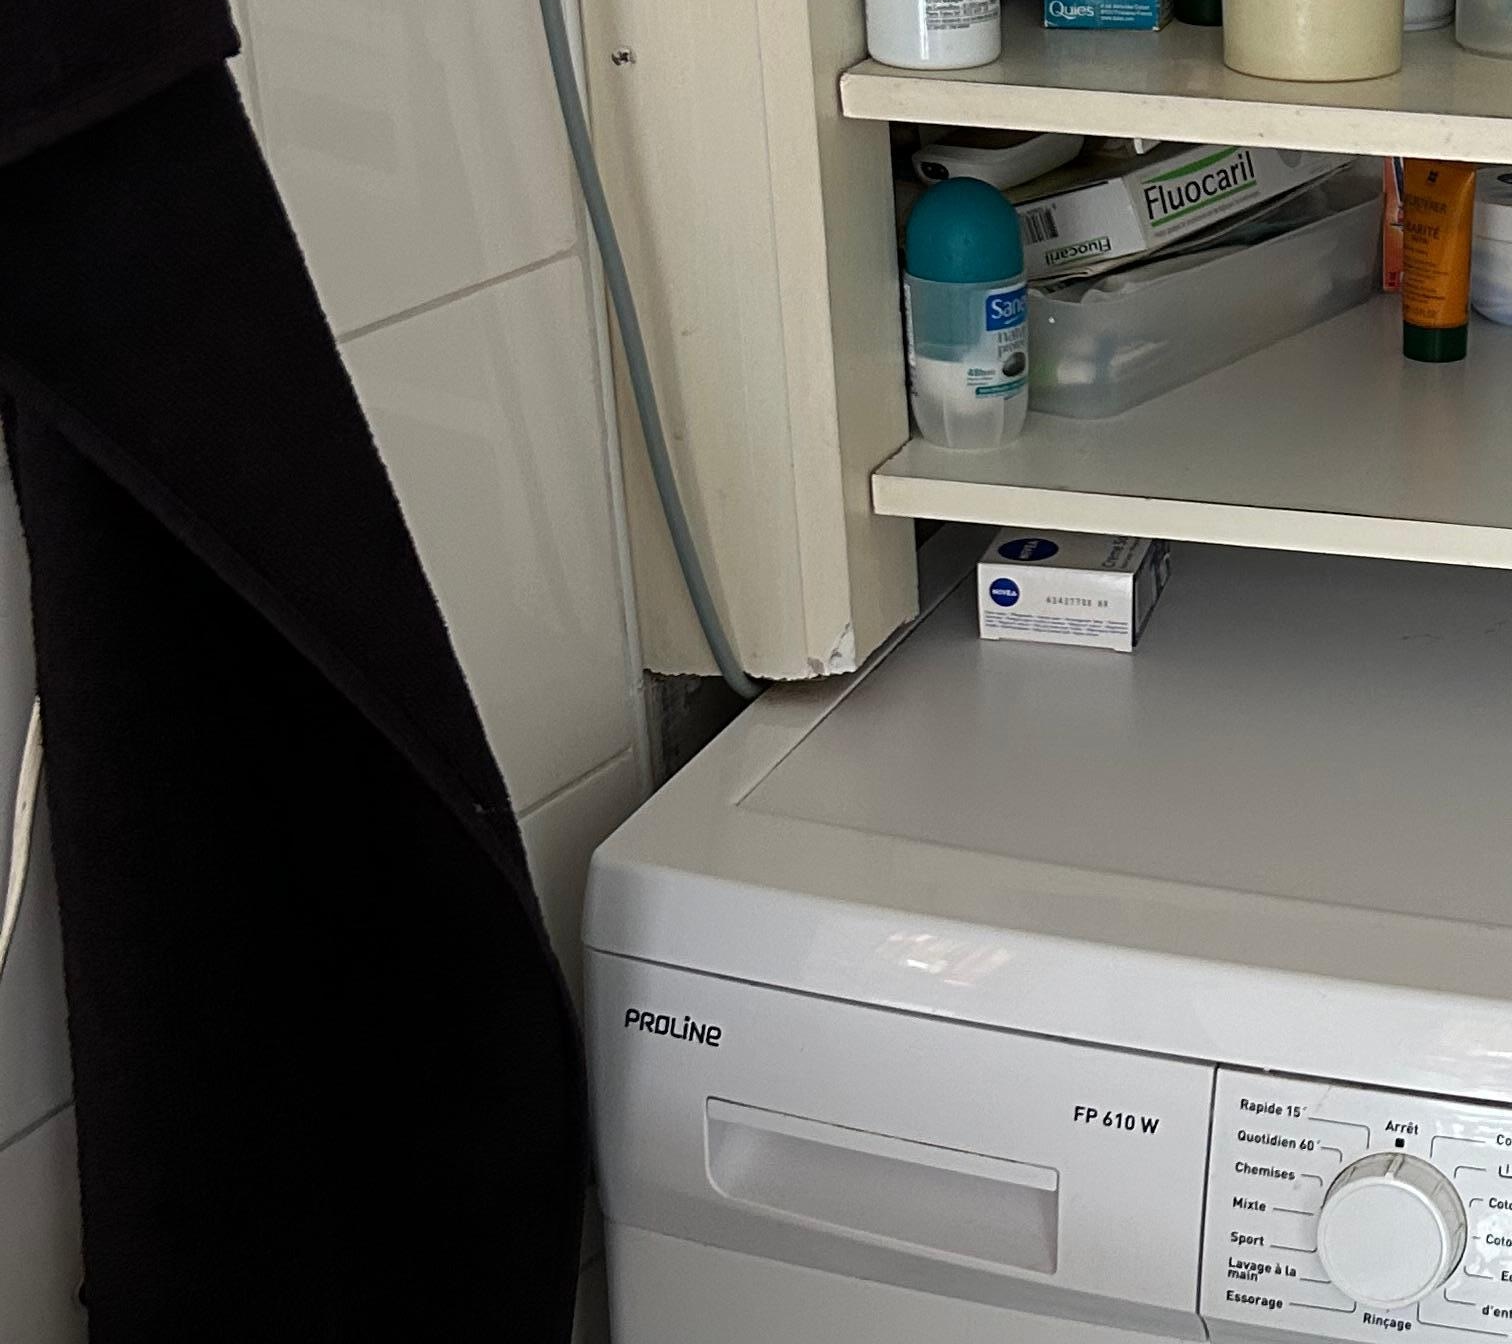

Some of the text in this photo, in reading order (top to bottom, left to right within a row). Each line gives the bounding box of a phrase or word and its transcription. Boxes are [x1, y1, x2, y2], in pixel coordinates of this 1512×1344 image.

[1049, 0, 1094, 20] Quies
[1144, 151, 1256, 220] Fluocaril
[1044, 235, 1113, 267] Fluocaril
[992, 588, 1018, 597] NIVEA
[1240, 1098, 1283, 1116] Rapide
[1073, 1105, 1160, 1135] FP 610 W
[1385, 1120, 1420, 1136] Arrêt
[1237, 1129, 1296, 1149] Quotidien
[1234, 1160, 1296, 1181] Chemises
[1230, 1231, 1266, 1248] Sport
[1227, 1269, 1259, 1282] main
[1228, 1256, 1297, 1277] Lavage à la
[1226, 1289, 1284, 1310] Essorage
[1363, 1312, 1412, 1332] Rinçage
